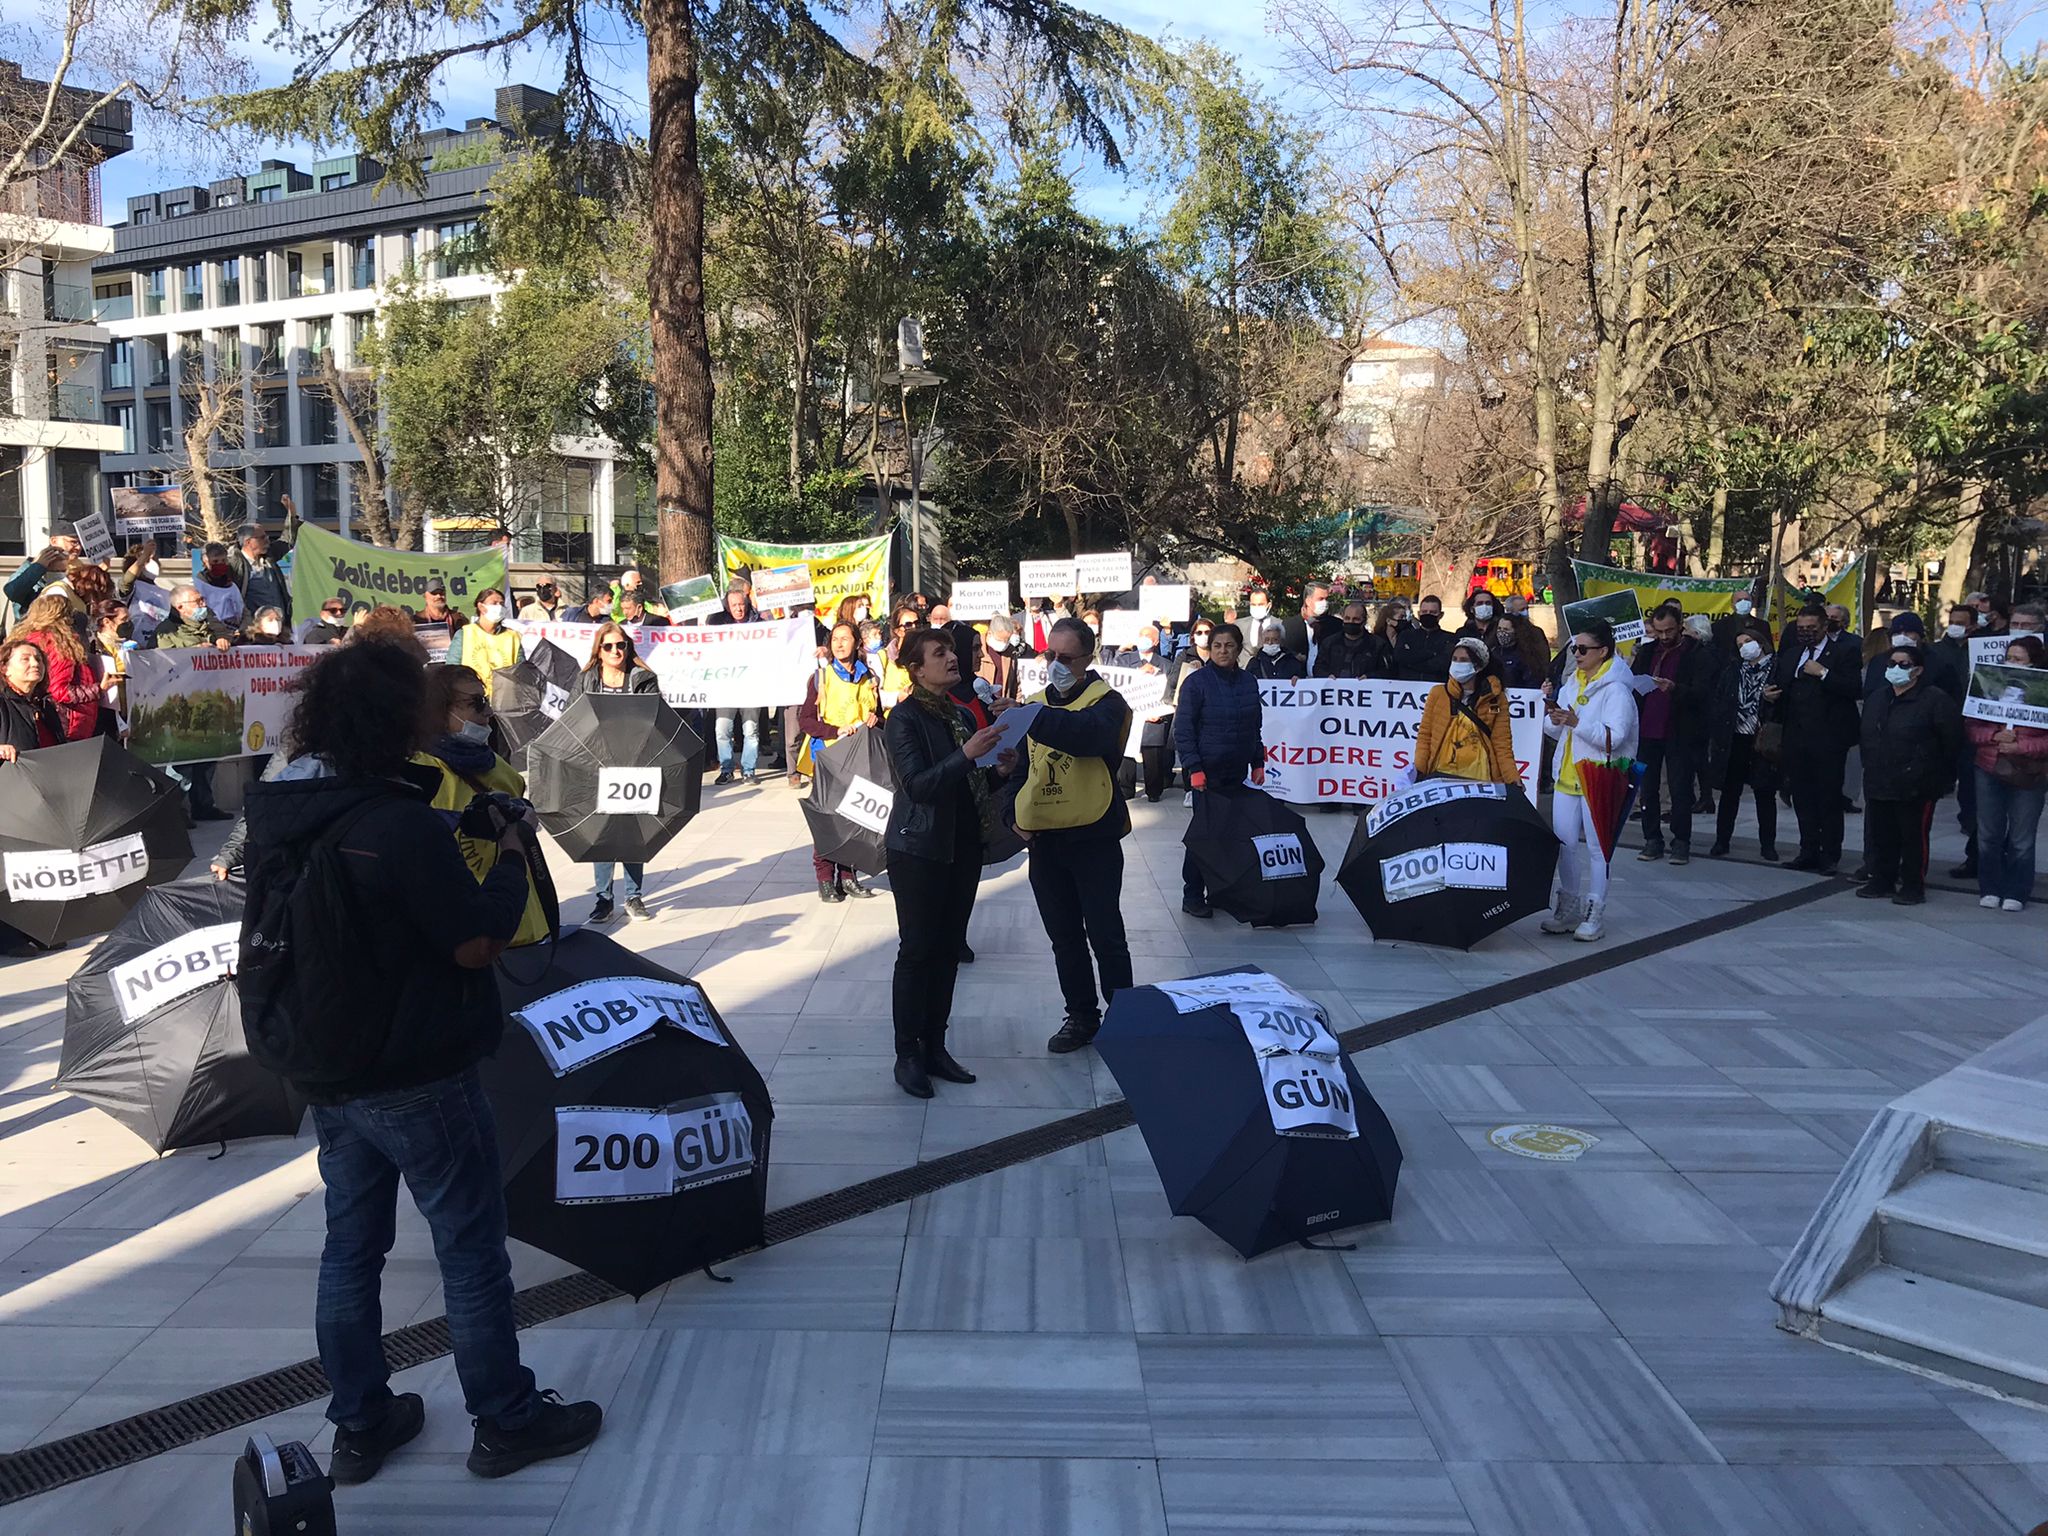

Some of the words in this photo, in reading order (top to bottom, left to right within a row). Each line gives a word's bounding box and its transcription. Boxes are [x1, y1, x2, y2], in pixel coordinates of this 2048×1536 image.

[1088, 575, 1120, 584] HAYIR
[651, 626, 778, 644] NÖBETİNDE
[244, 652, 277, 669] KORUSU
[251, 677, 277, 697] Düğün
[1259, 686, 1372, 708] KİZDERE
[547, 692, 566, 712] 20
[1264, 742, 1382, 768] KİZDERE
[607, 782, 652, 800] 200
[1041, 786, 1063, 796] 1998
[1318, 775, 1396, 799] DEĞİ
[850, 791, 889, 820] 200
[1370, 782, 1495, 832] NÖBETTE
[1262, 844, 1303, 868] GÜN
[1389, 854, 1439, 885] 200
[1447, 851, 1496, 872] GÜN
[12, 849, 147, 890] NÖBETTE
[1482, 901, 1511, 920] INESIS
[125, 940, 240, 1001] NÖBE
[1250, 1010, 1318, 1039] 200
[1272, 1069, 1350, 1114] GÜN
[573, 1133, 660, 1173] 200
[673, 1108, 751, 1173] GÜN
[1306, 1210, 1340, 1226] BEKO
